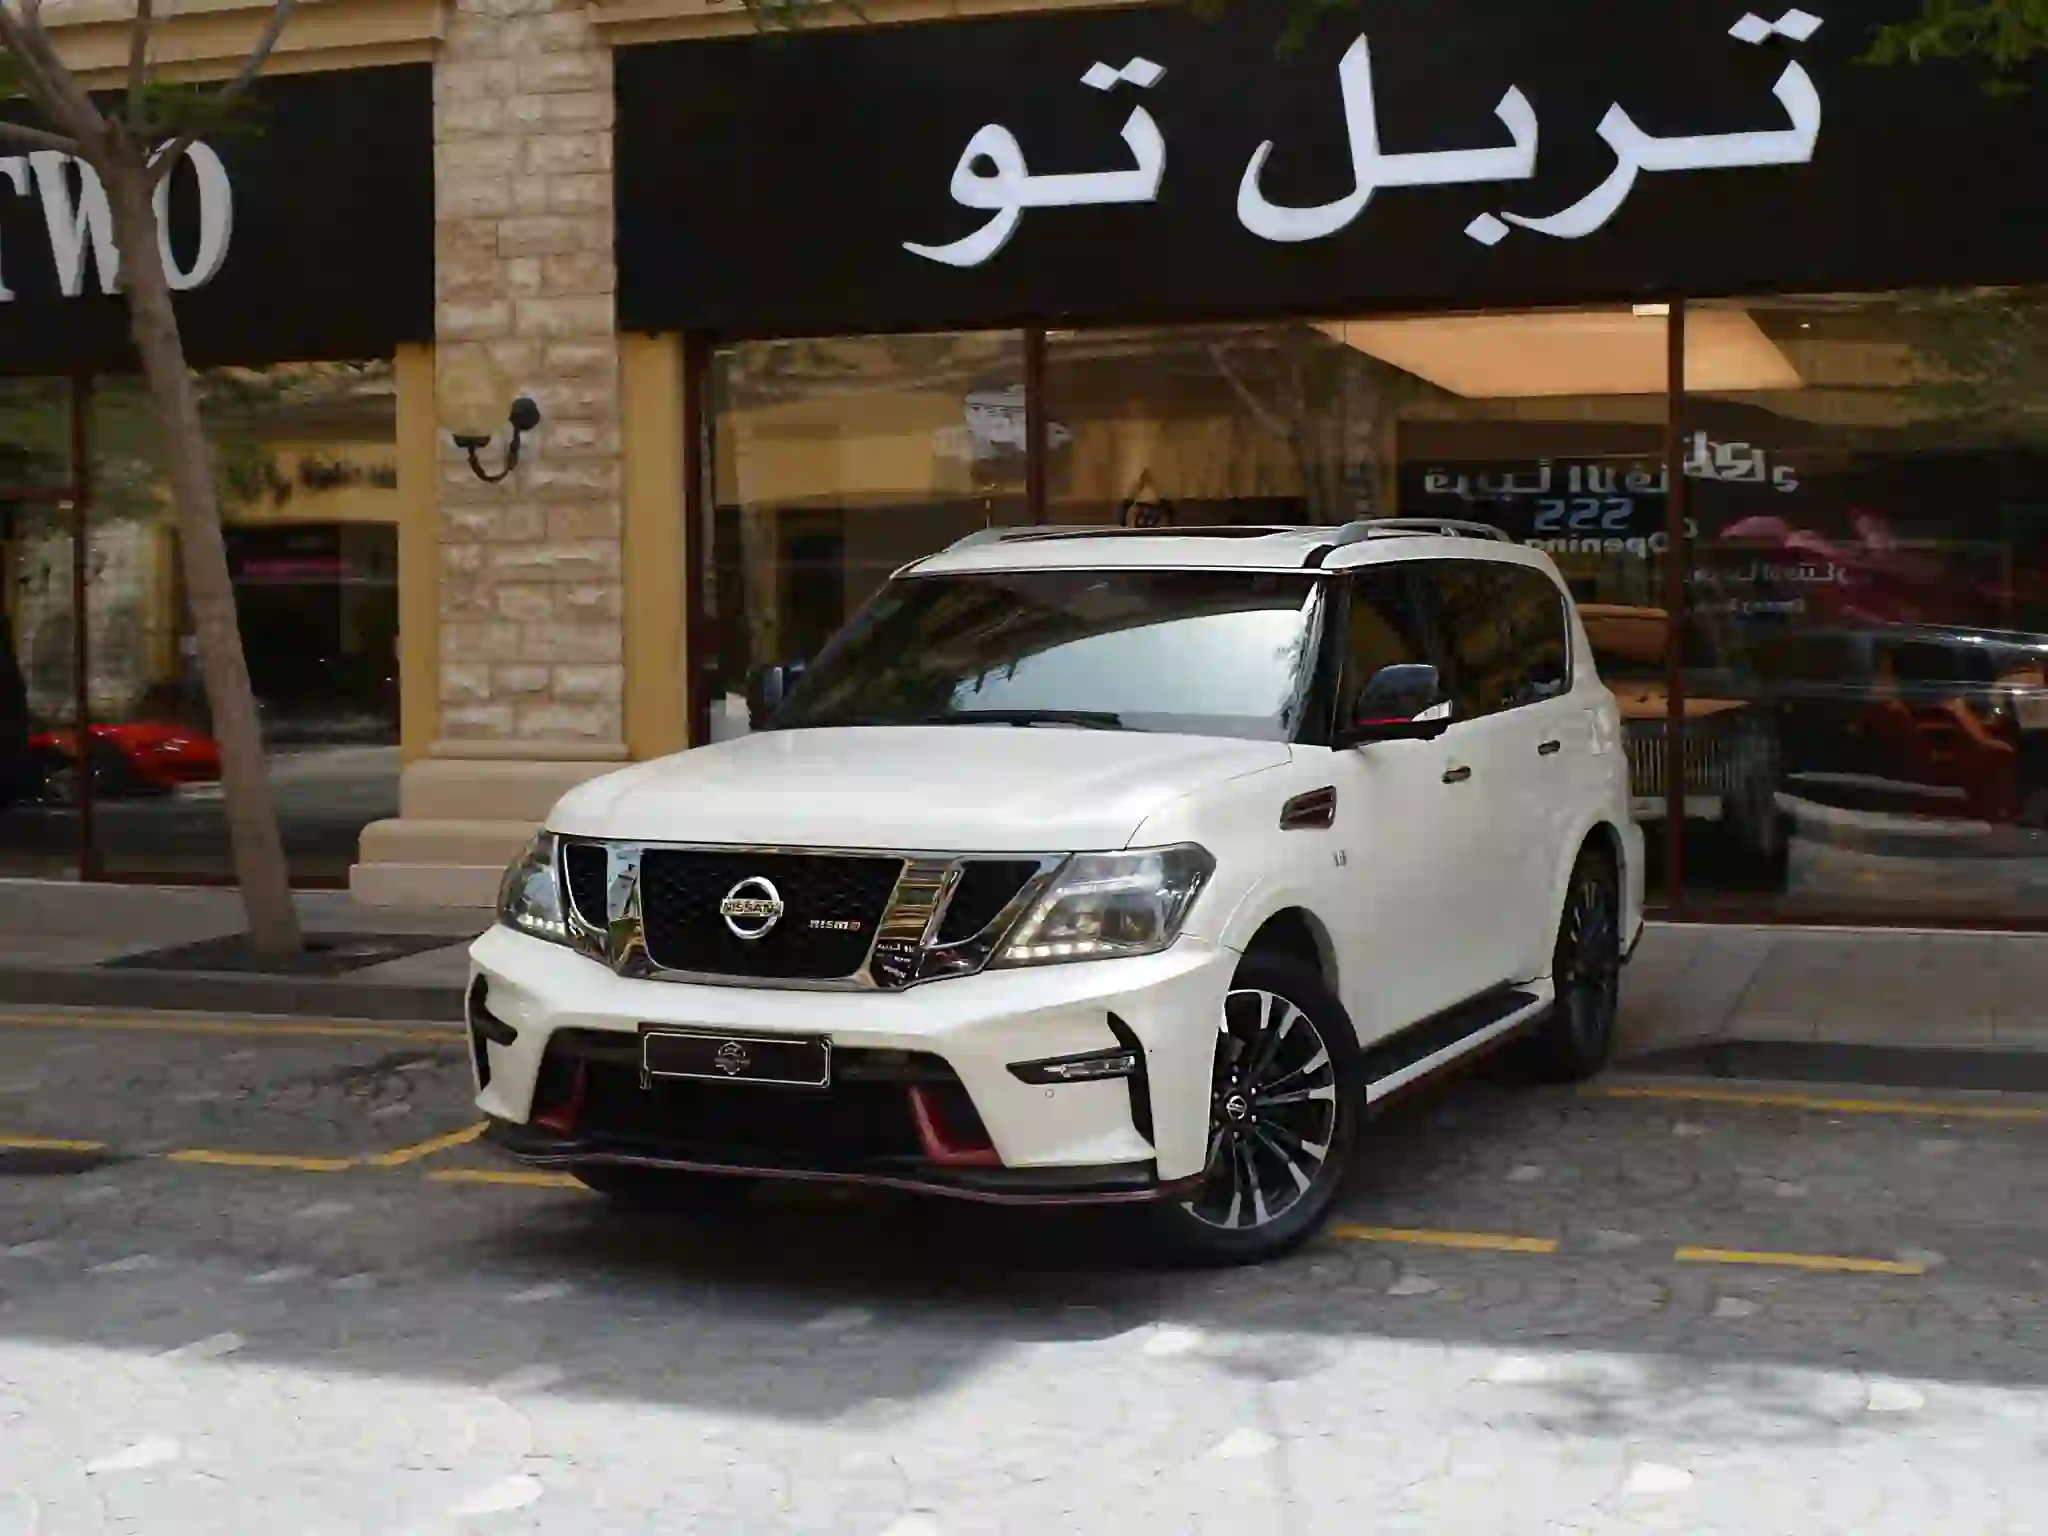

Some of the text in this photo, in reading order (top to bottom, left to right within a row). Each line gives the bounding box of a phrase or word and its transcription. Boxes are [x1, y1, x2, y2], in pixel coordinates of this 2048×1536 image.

[902, 8, 1823, 268] تربل تو
[722, 901, 776, 914] NISSAN
